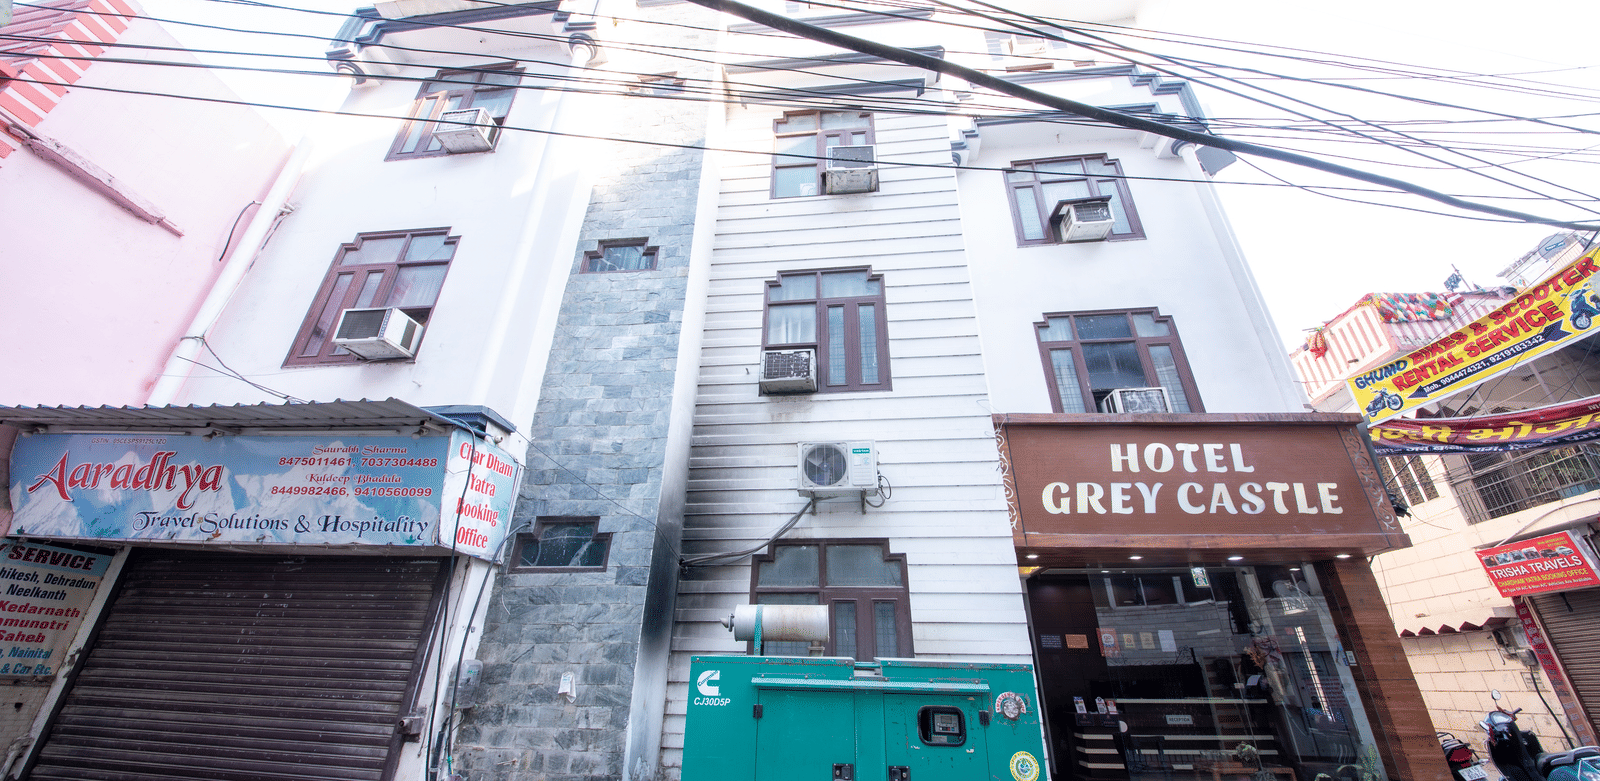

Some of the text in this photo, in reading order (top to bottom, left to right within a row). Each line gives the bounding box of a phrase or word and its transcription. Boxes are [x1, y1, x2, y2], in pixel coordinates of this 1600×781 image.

[1354, 256, 1600, 389] GHUMO BIKES & SCOOTER
[1392, 300, 1565, 392] RENTAL SERVICE
[1423, 335, 1546, 393] Mob. 9044474321, 9219183342
[312, 444, 408, 456] Saurabh Sharma
[459, 441, 514, 478] Char Dham
[1110, 442, 1255, 473] HOTEL
[278, 457, 438, 468] 8475011461, 7037304488
[28, 450, 224, 510] Aaradhya
[305, 473, 402, 485] Kuldeep Bhadula
[469, 473, 496, 497] Yatra
[271, 485, 432, 497] 8449982466, 9410560099
[1041, 481, 1343, 515] GREY CASTLE
[456, 496, 499, 527] Booking
[132, 511, 429, 540] Travel Solutions & Hospitality
[457, 526, 488, 549] Office
[8, 544, 97, 571] SERVICE
[1490, 555, 1584, 579] TRISHA TRAVELS
[44, 572, 96, 589] Dehradun
[1498, 568, 1589, 588] CHARDHAM YATRA BOOKING OFFICE
[6, 583, 67, 600] Neelkanth
[0, 600, 80, 618] Kedarnath
[0, 629, 46, 643] Saheb
[8, 646, 53, 659] Nainital
[12, 663, 32, 674] Car
[33, 663, 53, 675] Etc.
[693, 697, 731, 706] CJ30D5P
